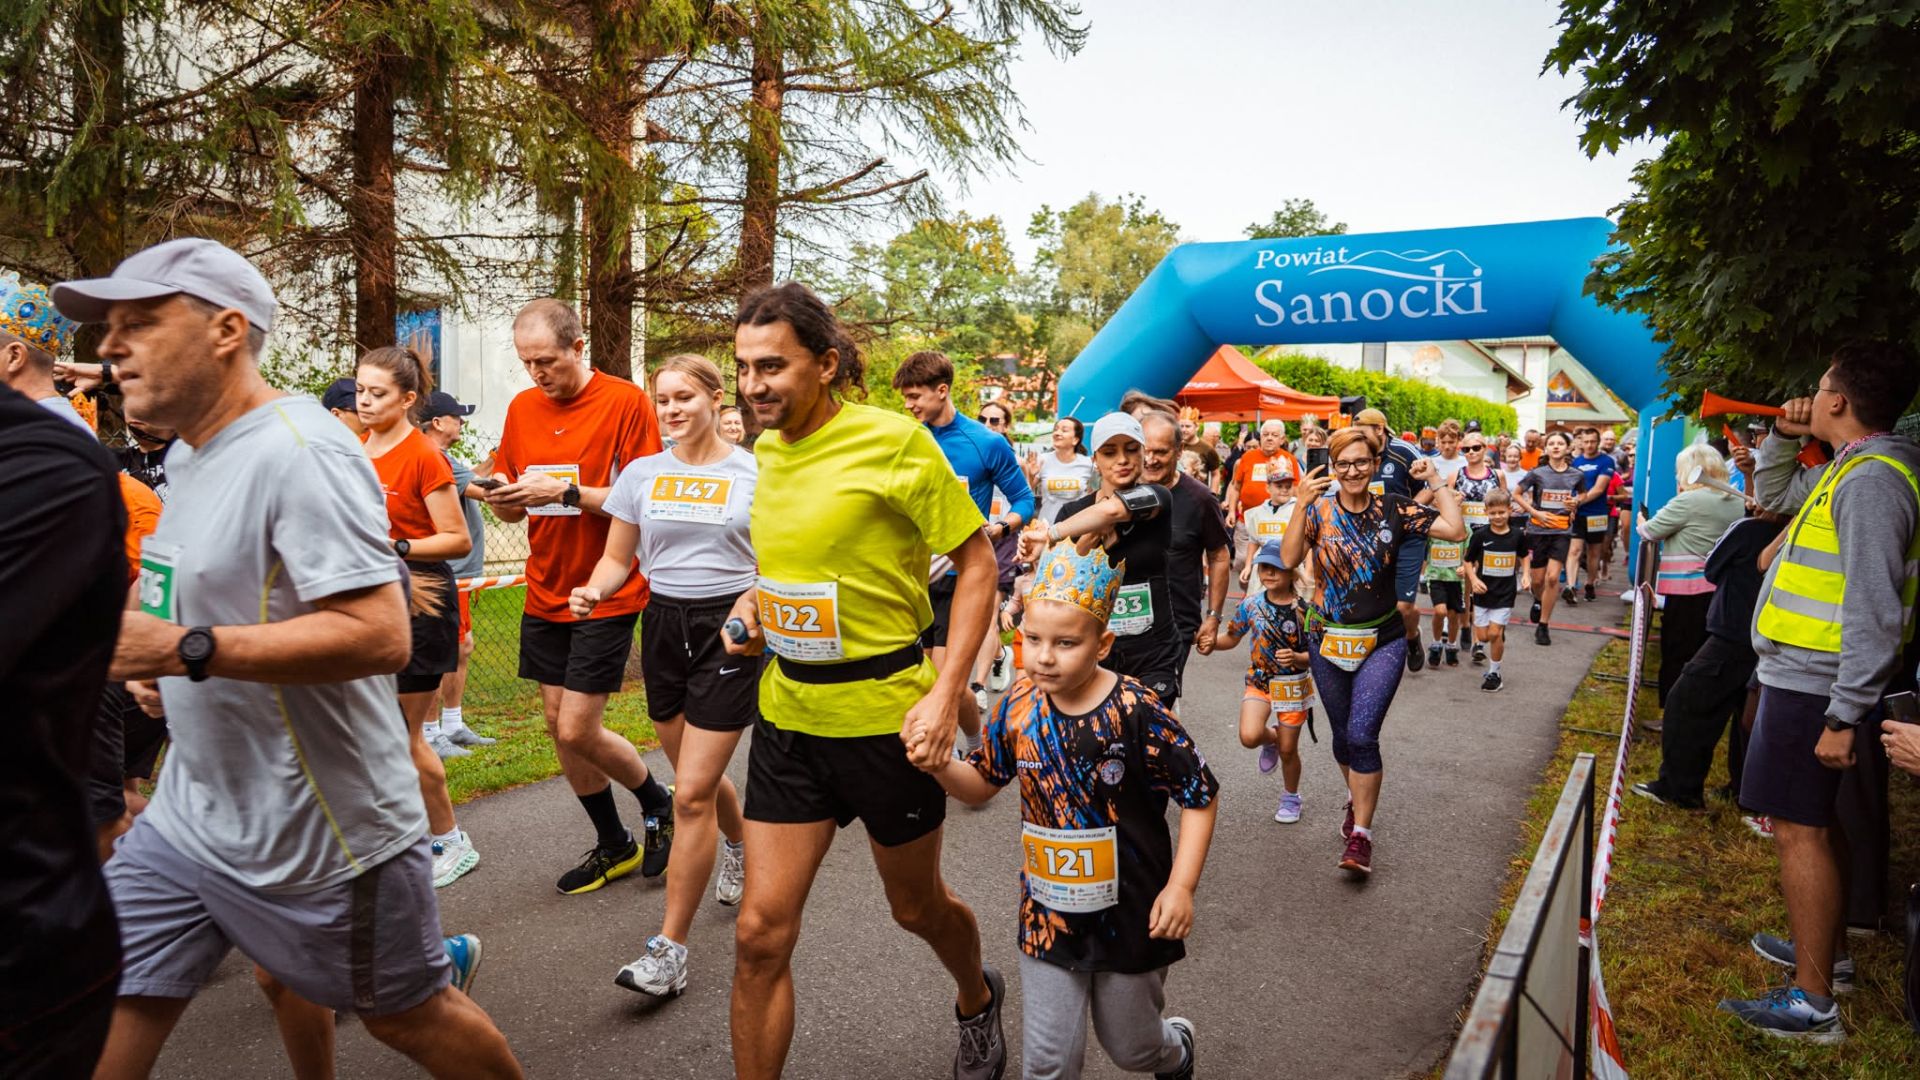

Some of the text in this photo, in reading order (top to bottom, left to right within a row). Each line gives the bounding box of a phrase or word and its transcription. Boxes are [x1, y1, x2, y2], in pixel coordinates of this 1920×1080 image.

[1254, 246, 1349, 270] Powiat
[1254, 264, 1488, 327] Sanocki
[674, 480, 720, 499] 147
[1438, 550, 1457, 558] 025
[1494, 557, 1512, 566] 011
[1112, 595, 1143, 615] 83
[772, 601, 822, 632] 122
[1336, 640, 1367, 656] 114
[1043, 846, 1095, 877] 121
